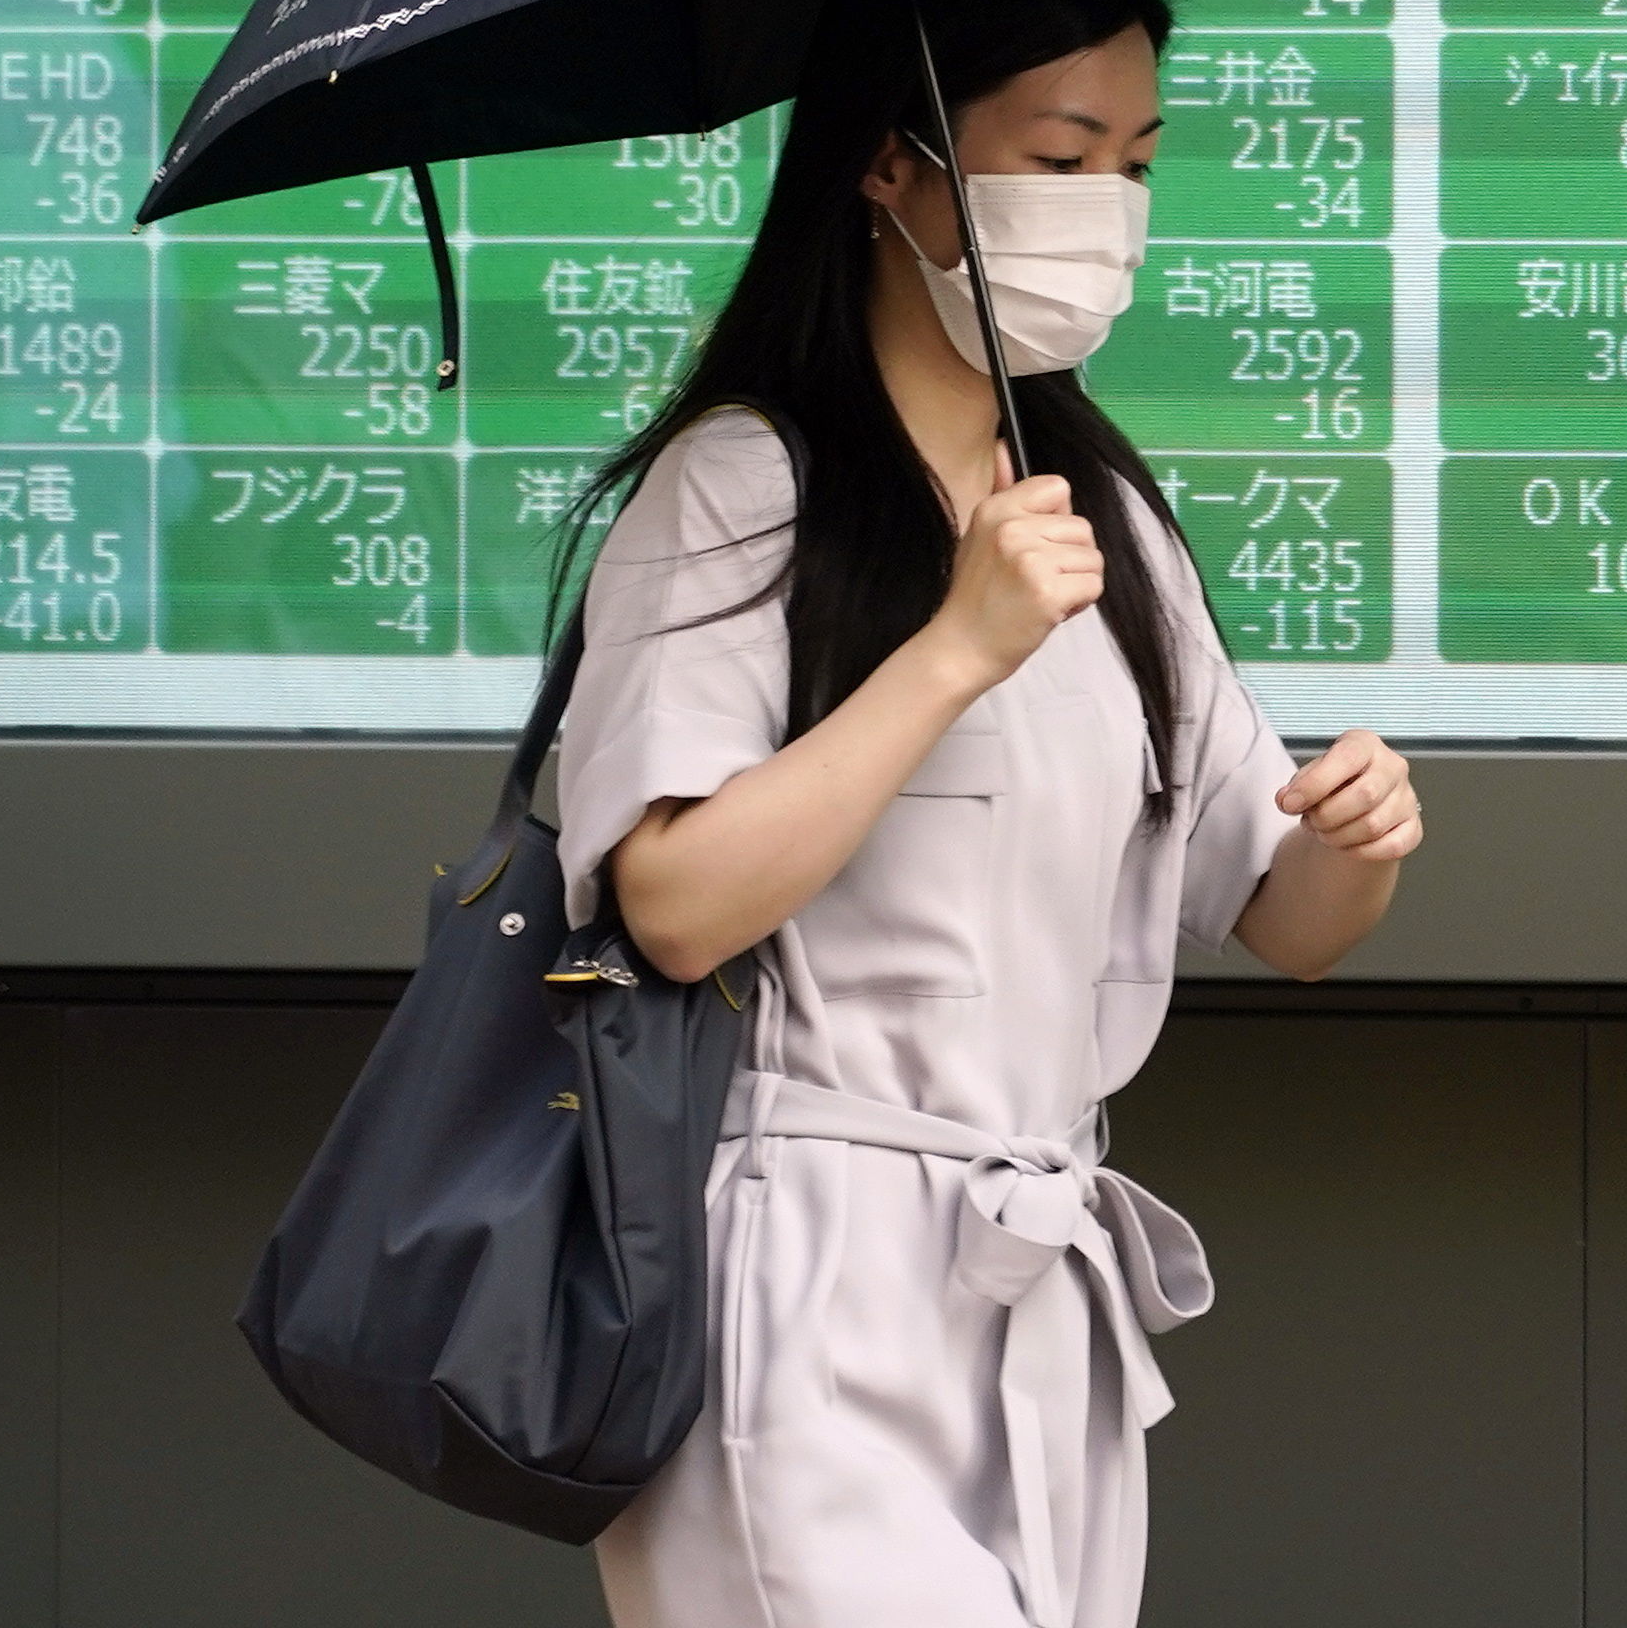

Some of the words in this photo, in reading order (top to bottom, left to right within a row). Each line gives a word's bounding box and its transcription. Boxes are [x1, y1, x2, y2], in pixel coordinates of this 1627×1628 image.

[234, 255, 384, 315] 三菱マ
[1164, 258, 1316, 320] 古河電
[300, 324, 430, 380] 2250
[1230, 328, 1364, 382] 2592
[35, 380, 122, 434] -24
[344, 382, 431, 437] -58
[1274, 387, 1364, 442] -16
[212, 464, 406, 524] フジクラ
[332, 534, 430, 588] 308
[376, 592, 431, 644] -4
